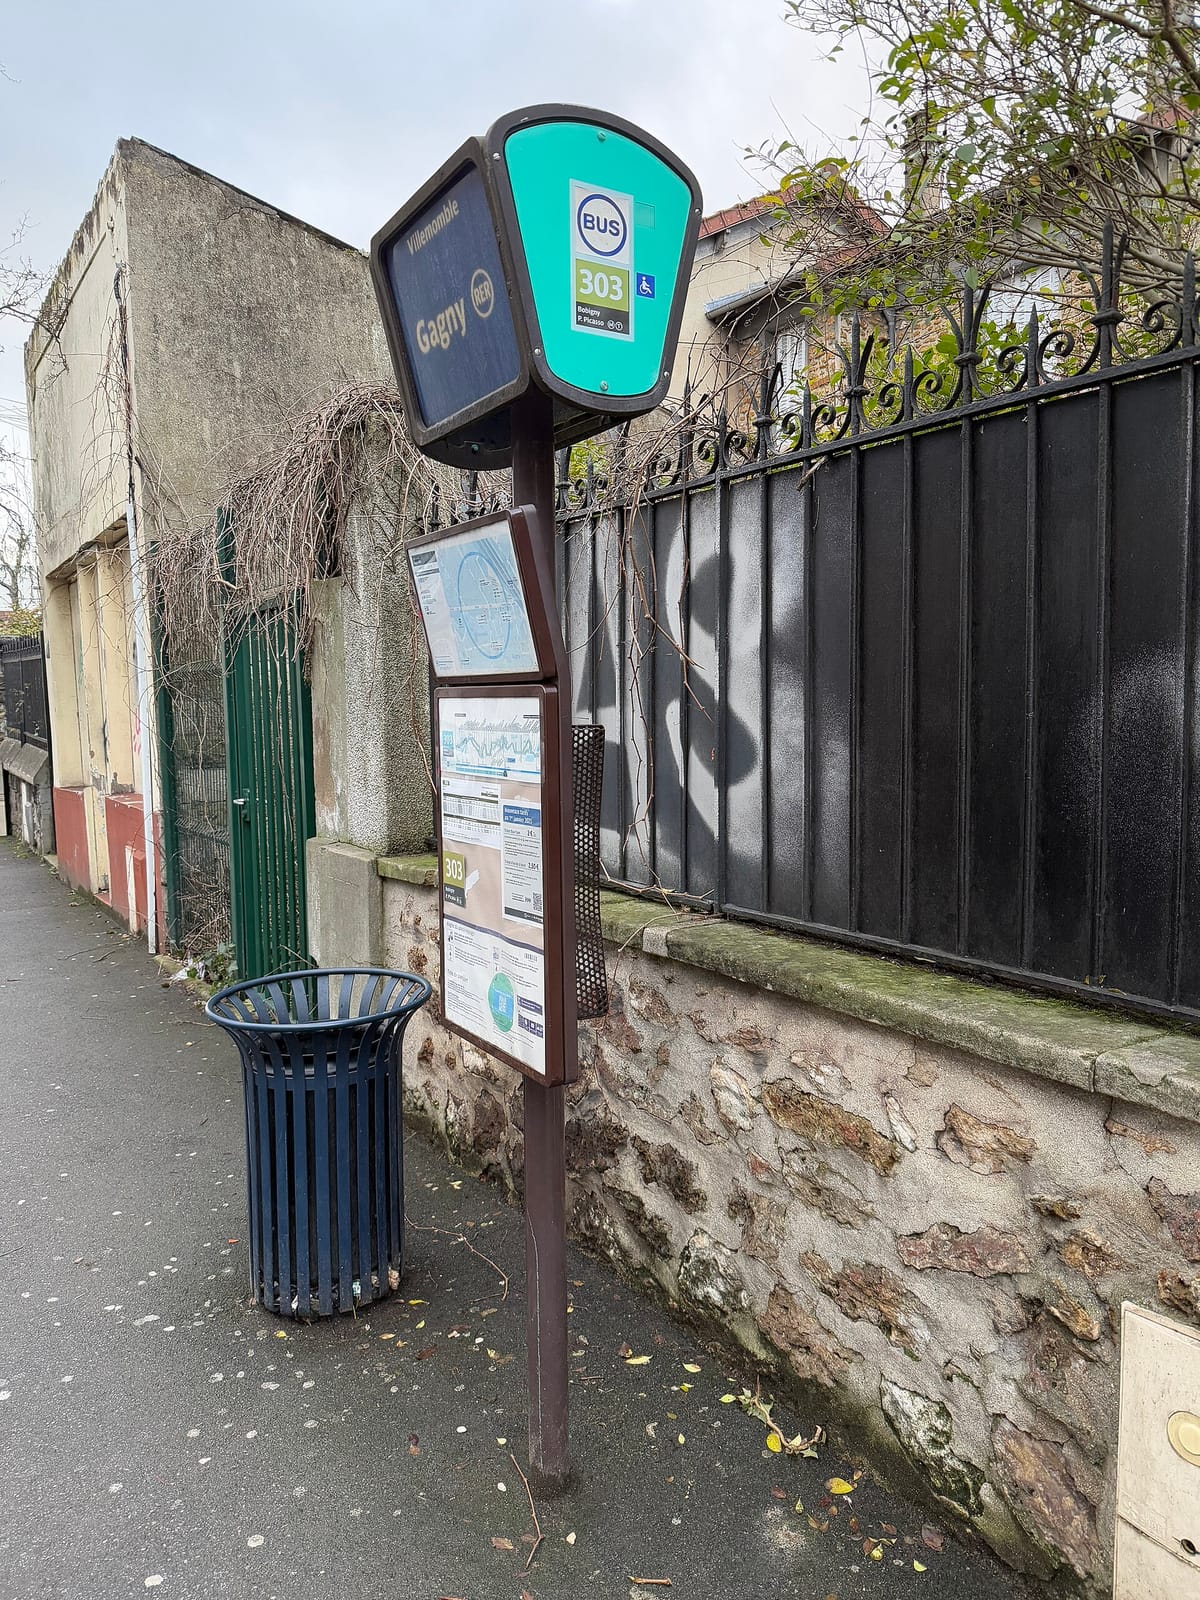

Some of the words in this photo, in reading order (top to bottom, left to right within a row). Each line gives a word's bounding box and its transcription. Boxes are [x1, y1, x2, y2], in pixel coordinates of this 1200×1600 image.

[407, 200, 459, 256] Villemomble
[583, 212, 620, 236] BUS
[474, 281, 491, 306] RER
[579, 268, 623, 300] 303
[577, 305, 600, 318] Bobigny
[583, 317, 605, 326] Picasso
[416, 297, 466, 353] Gagny
[445, 857, 462, 880] 303
